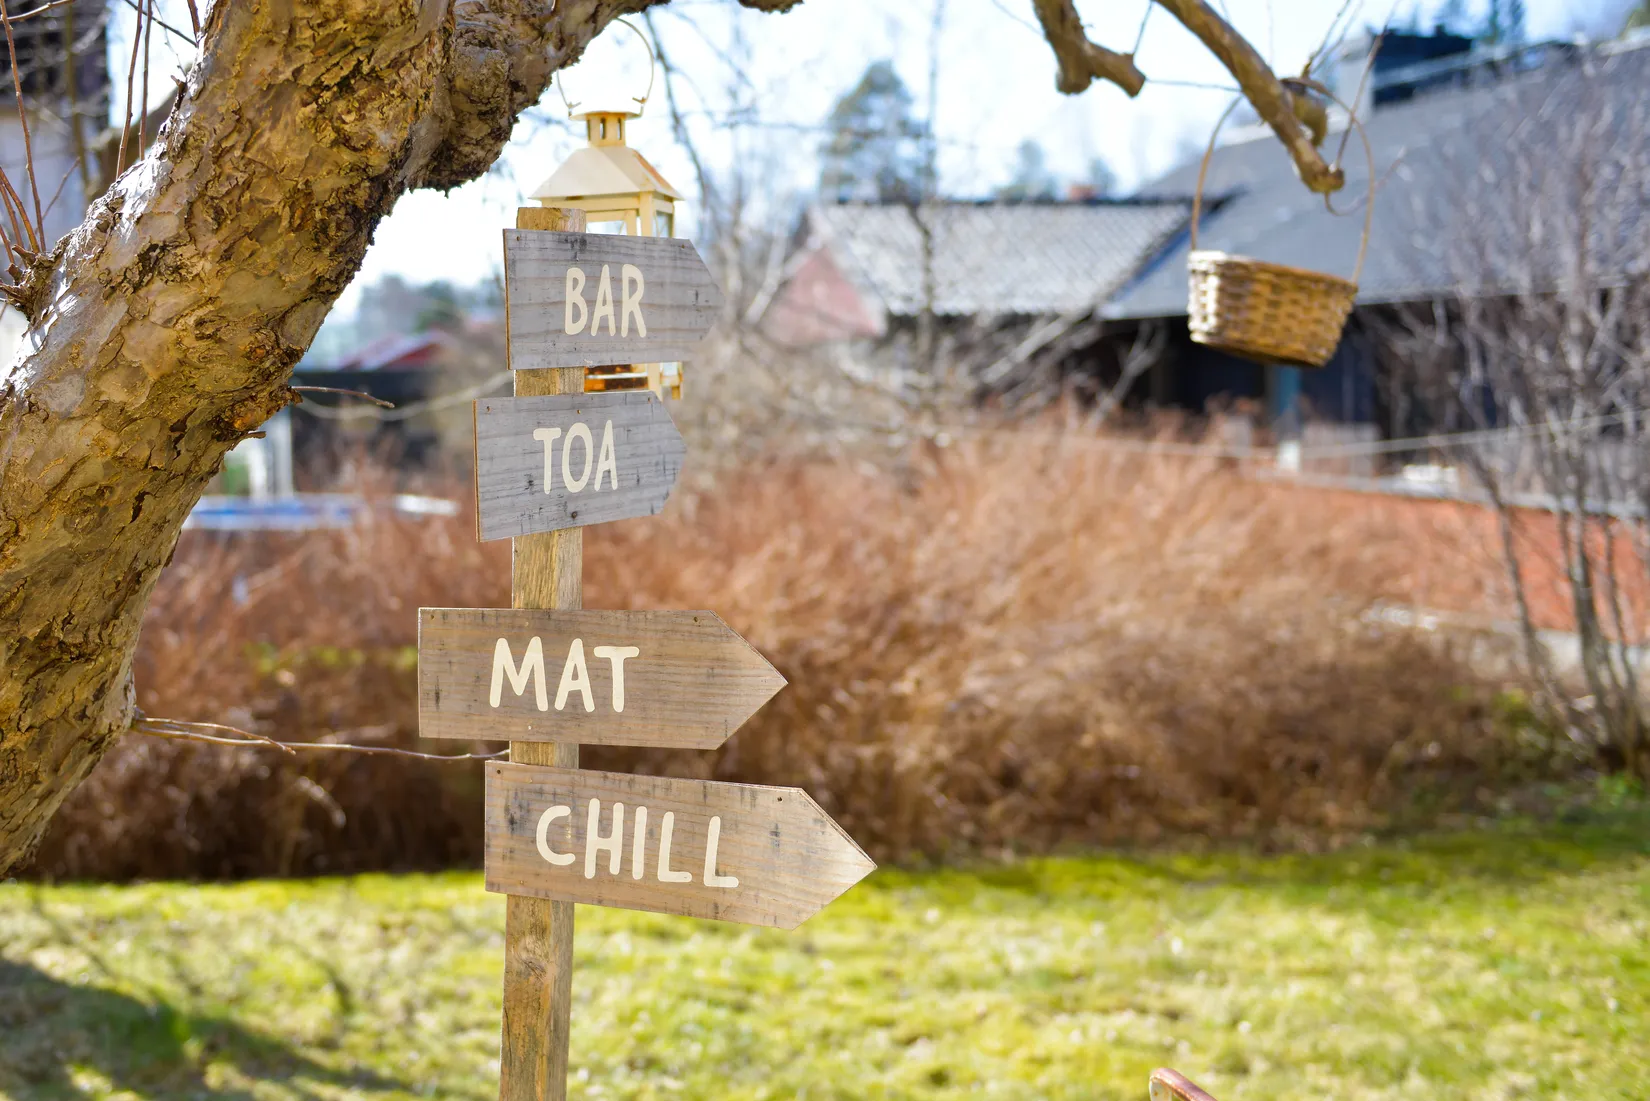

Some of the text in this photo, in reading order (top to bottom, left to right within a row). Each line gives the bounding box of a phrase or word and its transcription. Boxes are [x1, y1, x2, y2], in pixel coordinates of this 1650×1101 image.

[564, 263, 648, 339] BAR
[532, 419, 619, 495] TOA
[489, 636, 640, 713] MAT
[535, 797, 740, 889] CHILL
